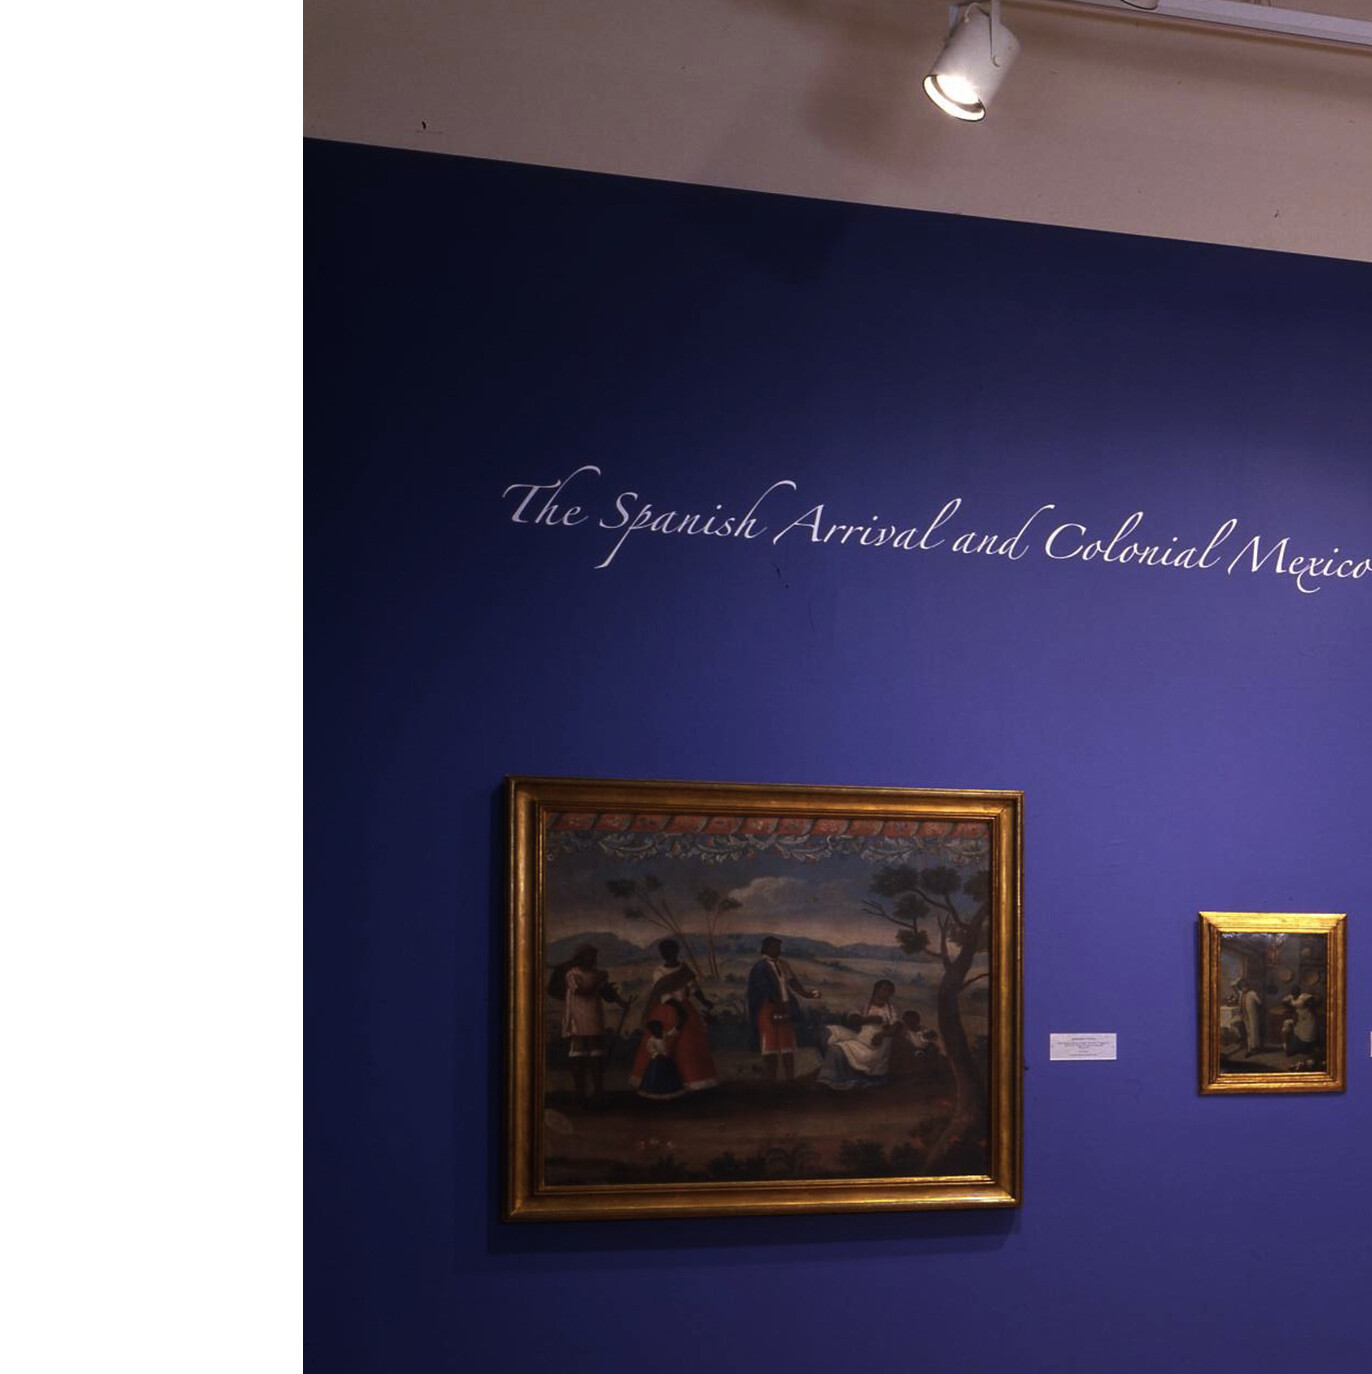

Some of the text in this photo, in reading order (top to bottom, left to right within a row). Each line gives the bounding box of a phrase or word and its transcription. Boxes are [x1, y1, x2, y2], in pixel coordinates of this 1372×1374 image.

[502, 465, 601, 526] The
[594, 480, 797, 569] Spanish
[773, 498, 962, 546] Arrival
[952, 504, 1055, 560] and
[1044, 511, 1238, 569] Colonial
